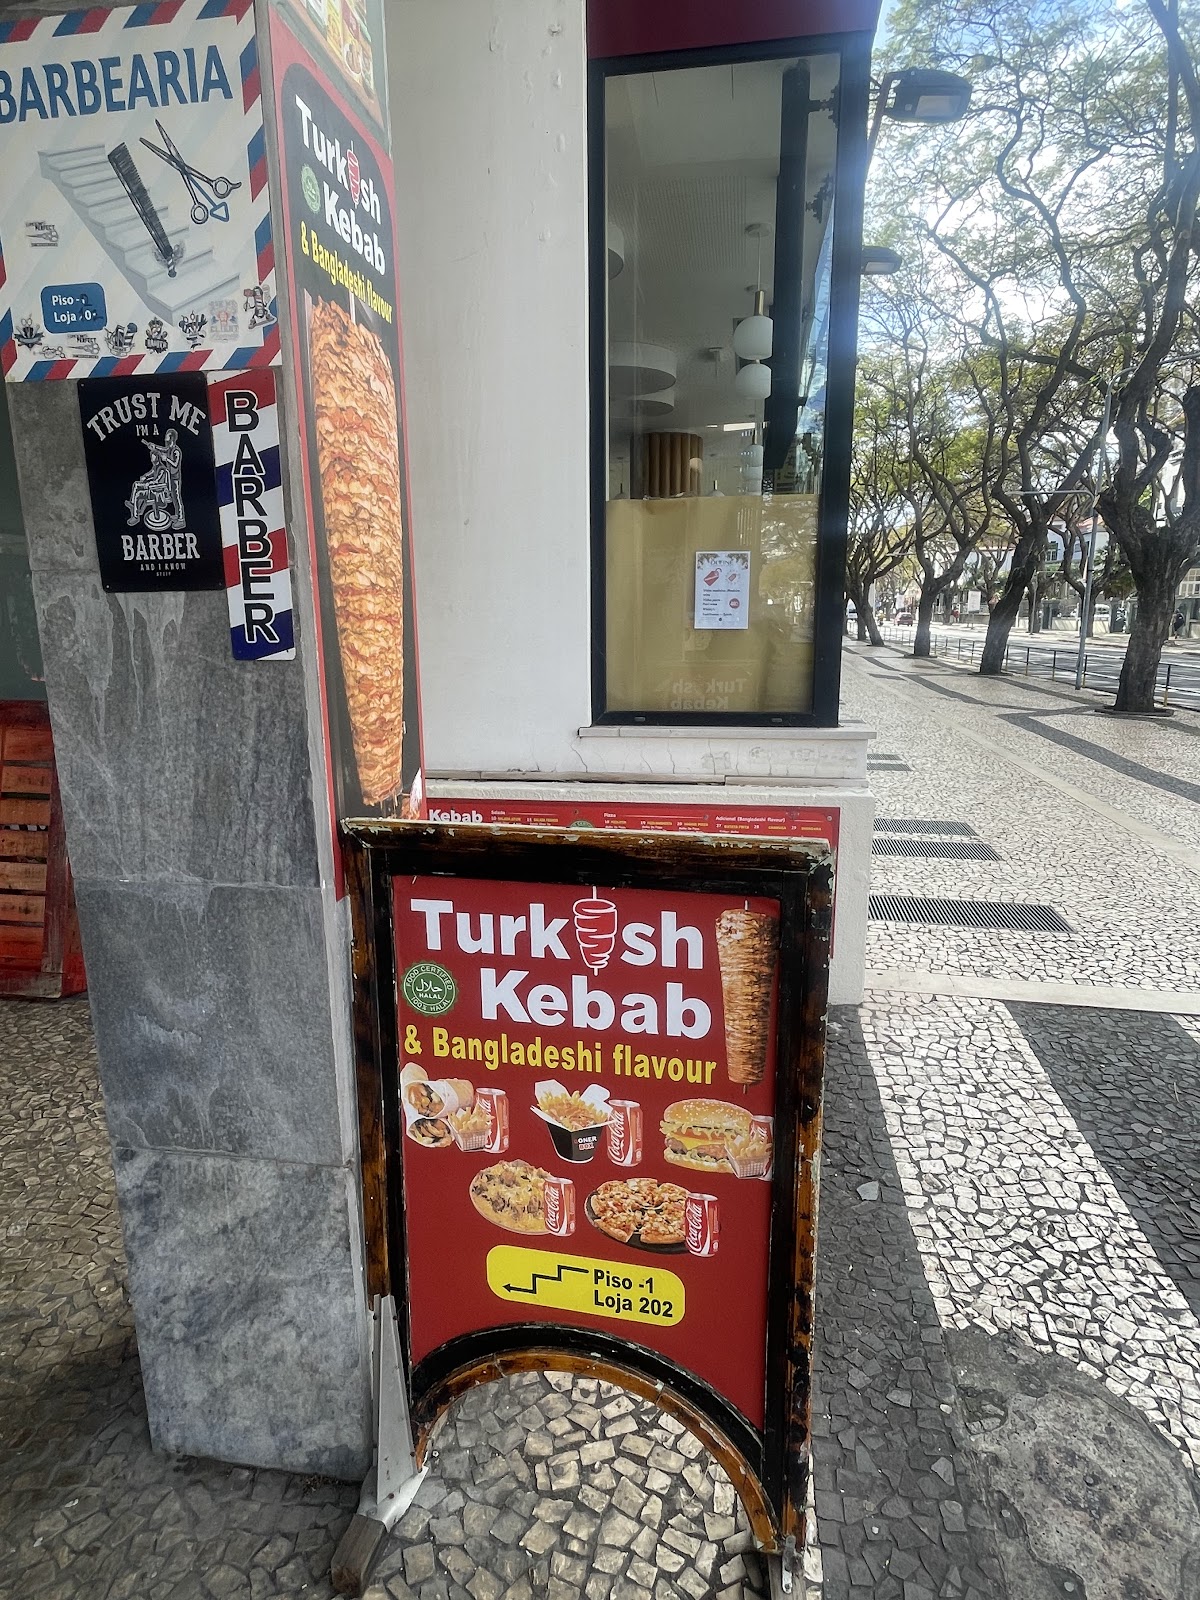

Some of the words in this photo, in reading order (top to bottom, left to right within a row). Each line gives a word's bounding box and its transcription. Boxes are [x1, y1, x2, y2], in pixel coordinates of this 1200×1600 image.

[0, 45, 234, 124] BARBEARIA
[322, 180, 386, 276] Kebab
[300, 220, 309, 256] &
[310, 229, 366, 302] Bangladeshi
[366, 278, 393, 324] flavour
[51, 294, 74, 306] Piso
[53, 311, 77, 325] Loja
[86, 392, 161, 442] TRUST
[168, 394, 207, 436] ME
[135, 424, 150, 437] I'M
[153, 423, 160, 436] A
[224, 390, 280, 644] BARBER
[121, 532, 201, 561] BARBER
[140, 563, 155, 571] AND
[165, 562, 186, 570] KNOW
[428, 808, 483, 823] Kebab
[406, 968, 420, 987] FOOD
[420, 965, 453, 990] CERTIFIED
[415, 978, 443, 993] حلال
[430, 999, 451, 1012] HALAL
[480, 967, 712, 1040] Kebab
[404, 1024, 423, 1056] &
[432, 1025, 602, 1073] Bangladeshi
[613, 1043, 718, 1086] flavour
[578, 1143, 595, 1151] BOX
[593, 1268, 634, 1291] Piso
[638, 1277, 656, 1295] -1
[593, 1289, 634, 1315] Loja
[638, 1296, 674, 1319] 202
